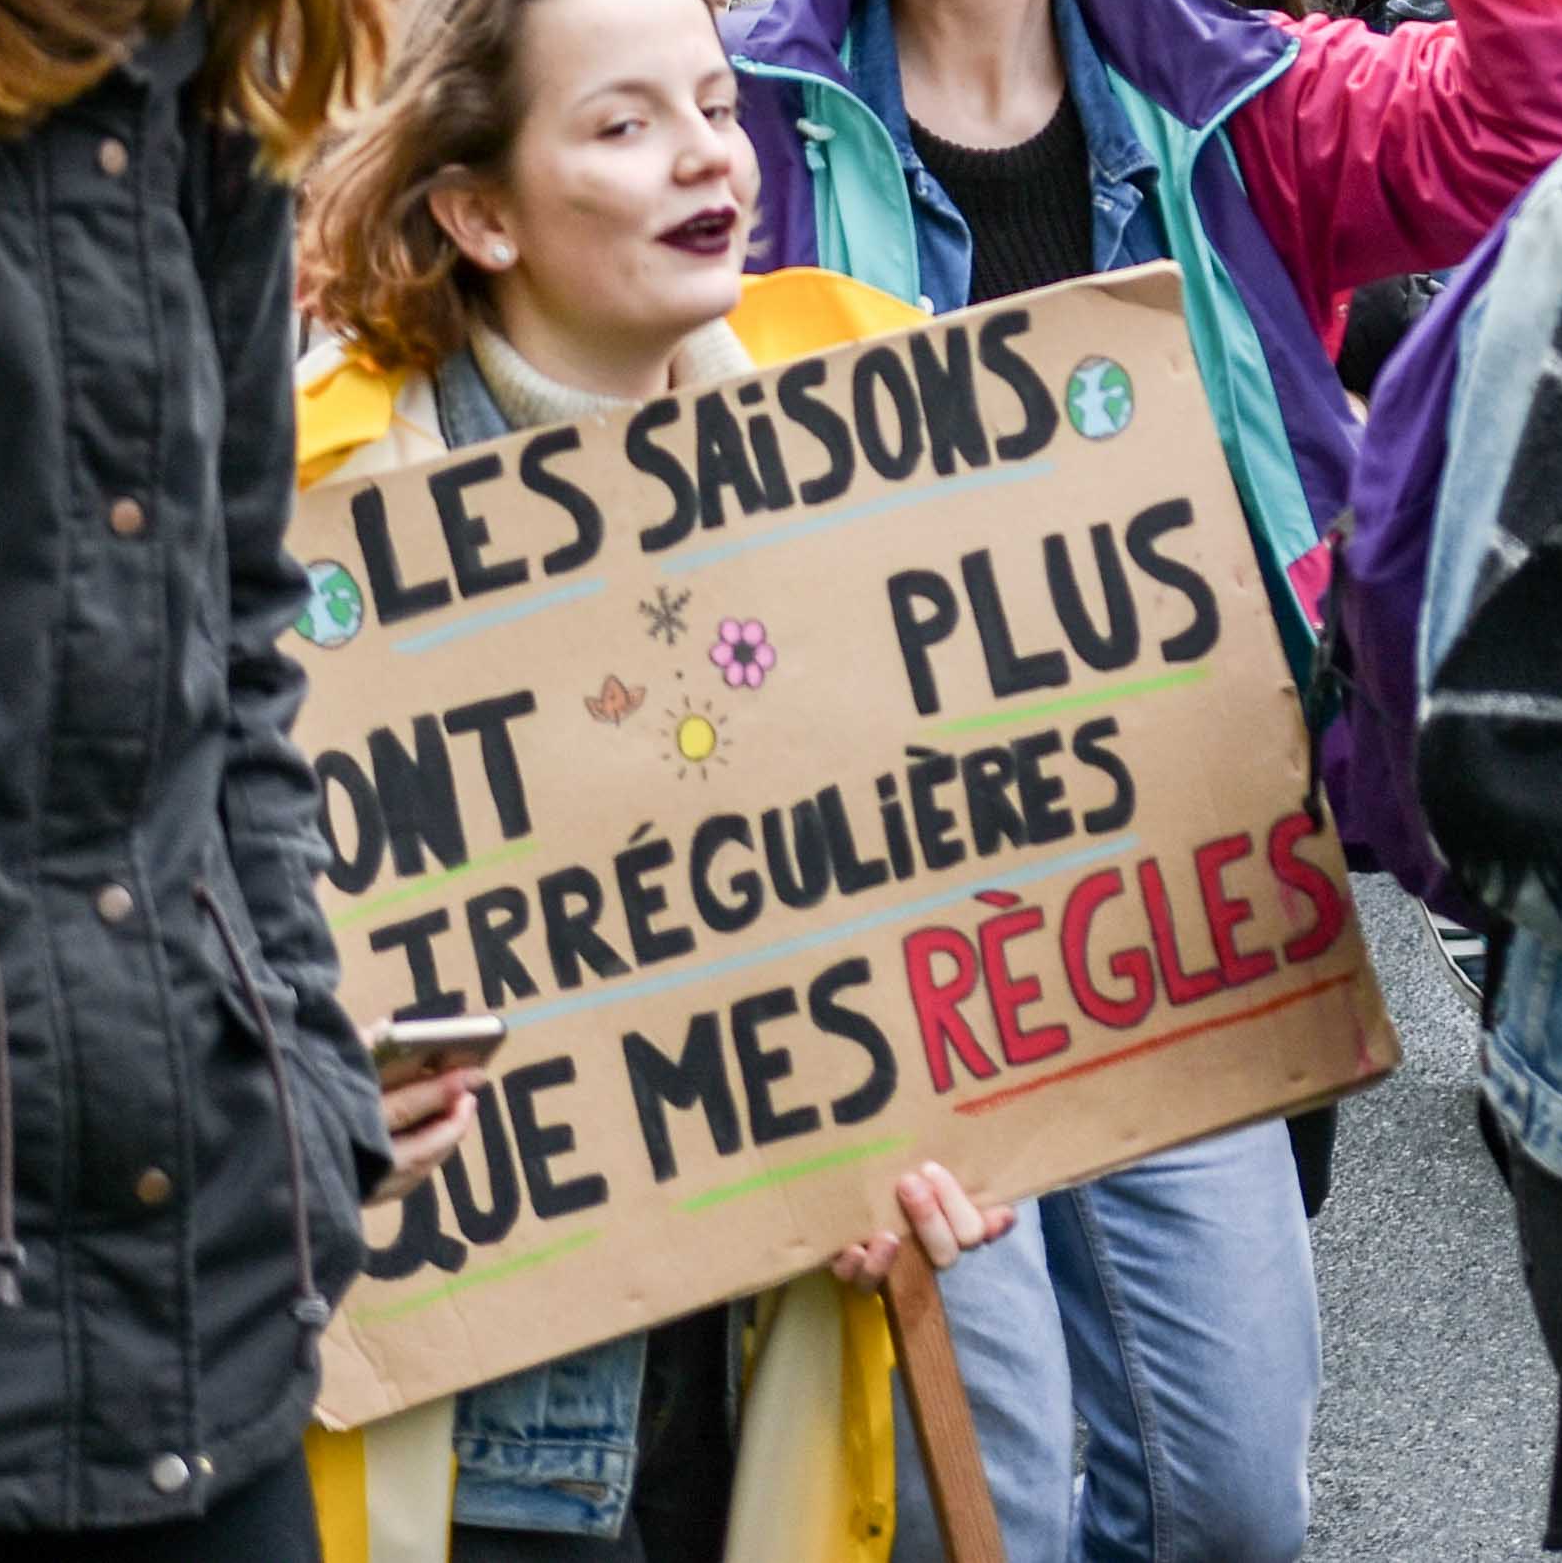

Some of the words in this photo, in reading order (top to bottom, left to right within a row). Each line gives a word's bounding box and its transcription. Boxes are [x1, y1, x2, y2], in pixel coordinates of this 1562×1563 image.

[350, 426, 607, 626] LES
[887, 498, 1220, 717] PLUS
[623, 956, 897, 1183] MES
[903, 811, 1351, 1095] RÈGLES
